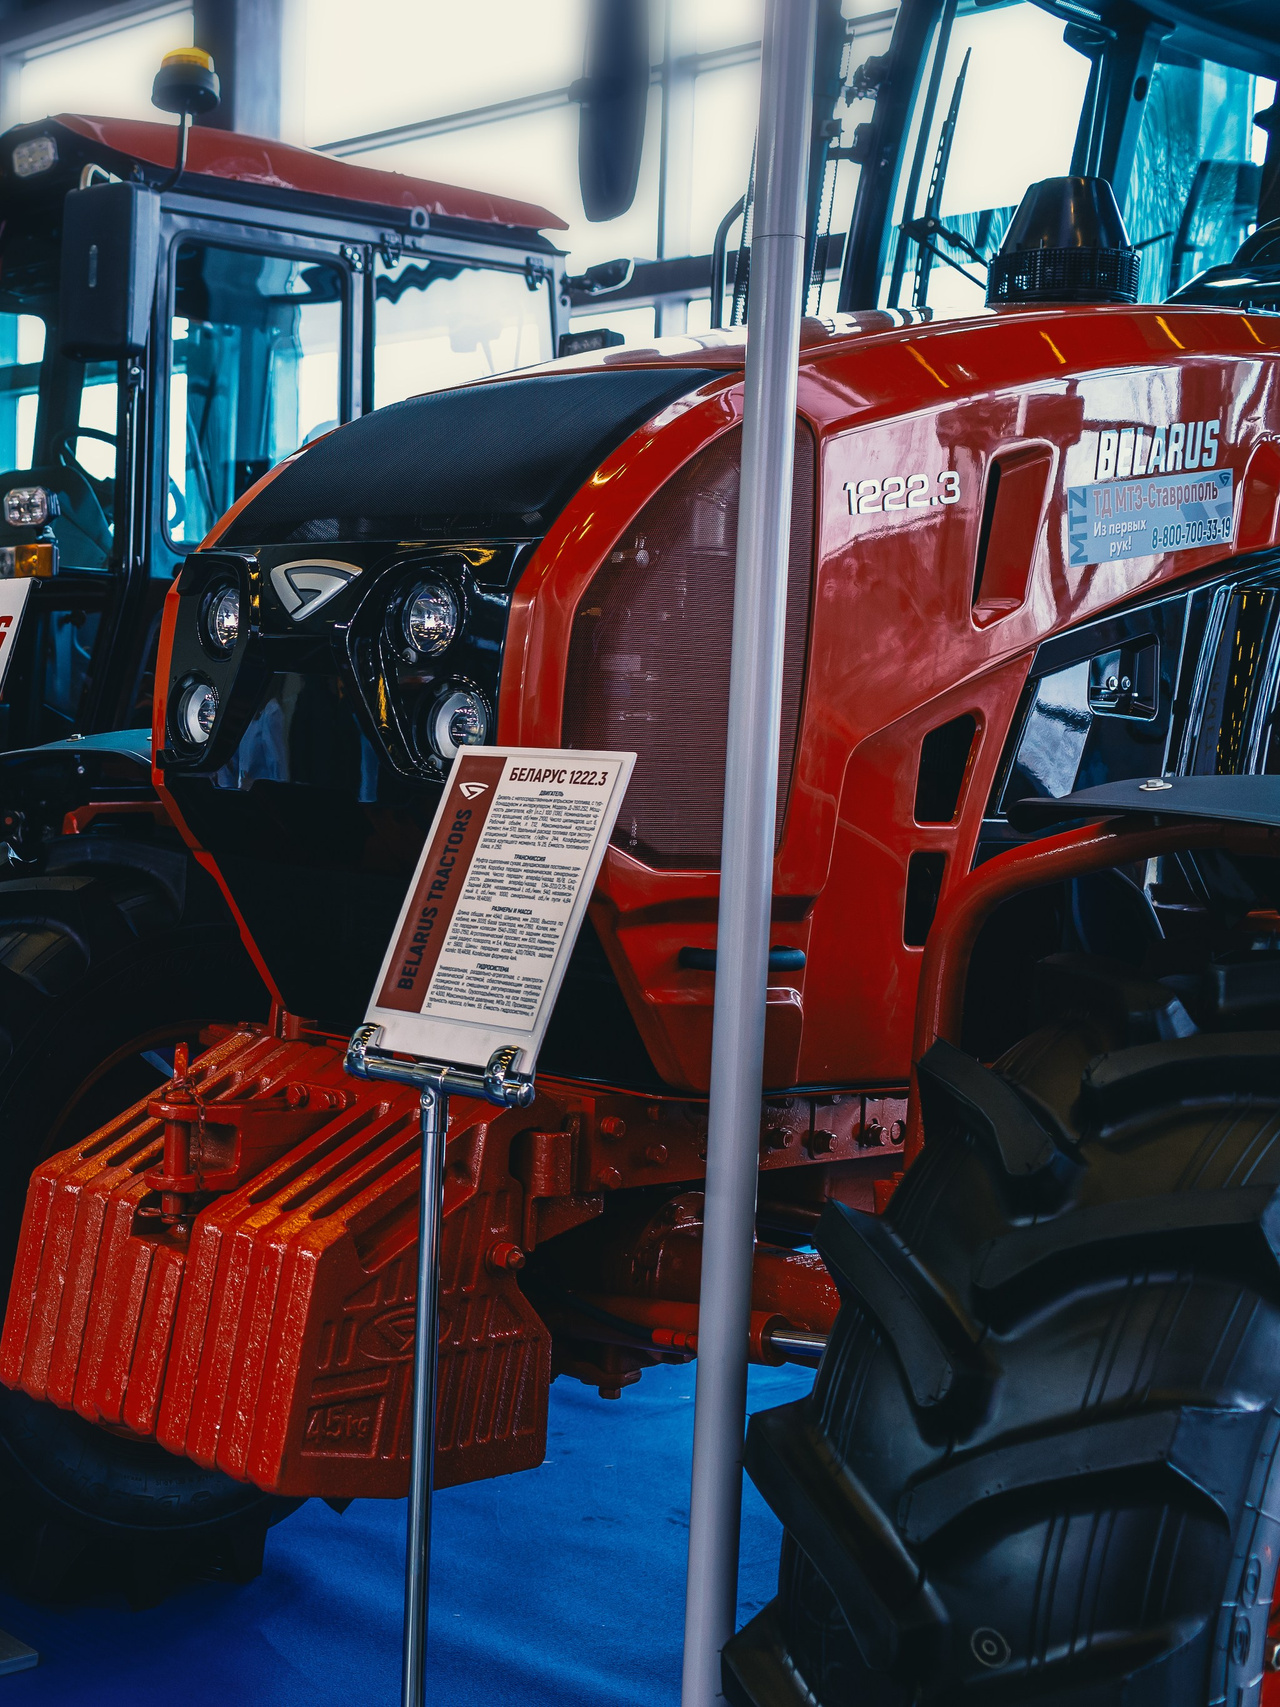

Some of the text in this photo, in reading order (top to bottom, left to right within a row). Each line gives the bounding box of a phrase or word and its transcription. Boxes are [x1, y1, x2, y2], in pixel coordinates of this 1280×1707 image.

[1095, 420, 1220, 480] BELARUS
[843, 470, 961, 516] 1222.3
[1093, 482, 1218, 519] ТД МТЗ-Ставрополь
[1069, 487, 1089, 564] MTZ
[1093, 519, 1146, 538] Из первых
[1151, 516, 1231, 549] 8-800-700-33-19
[1109, 536, 1133, 558] рук!
[509, 766, 609, 786] БЕЛАРУС 1222.3
[397, 808, 473, 991] BELARUS TRACTORS
